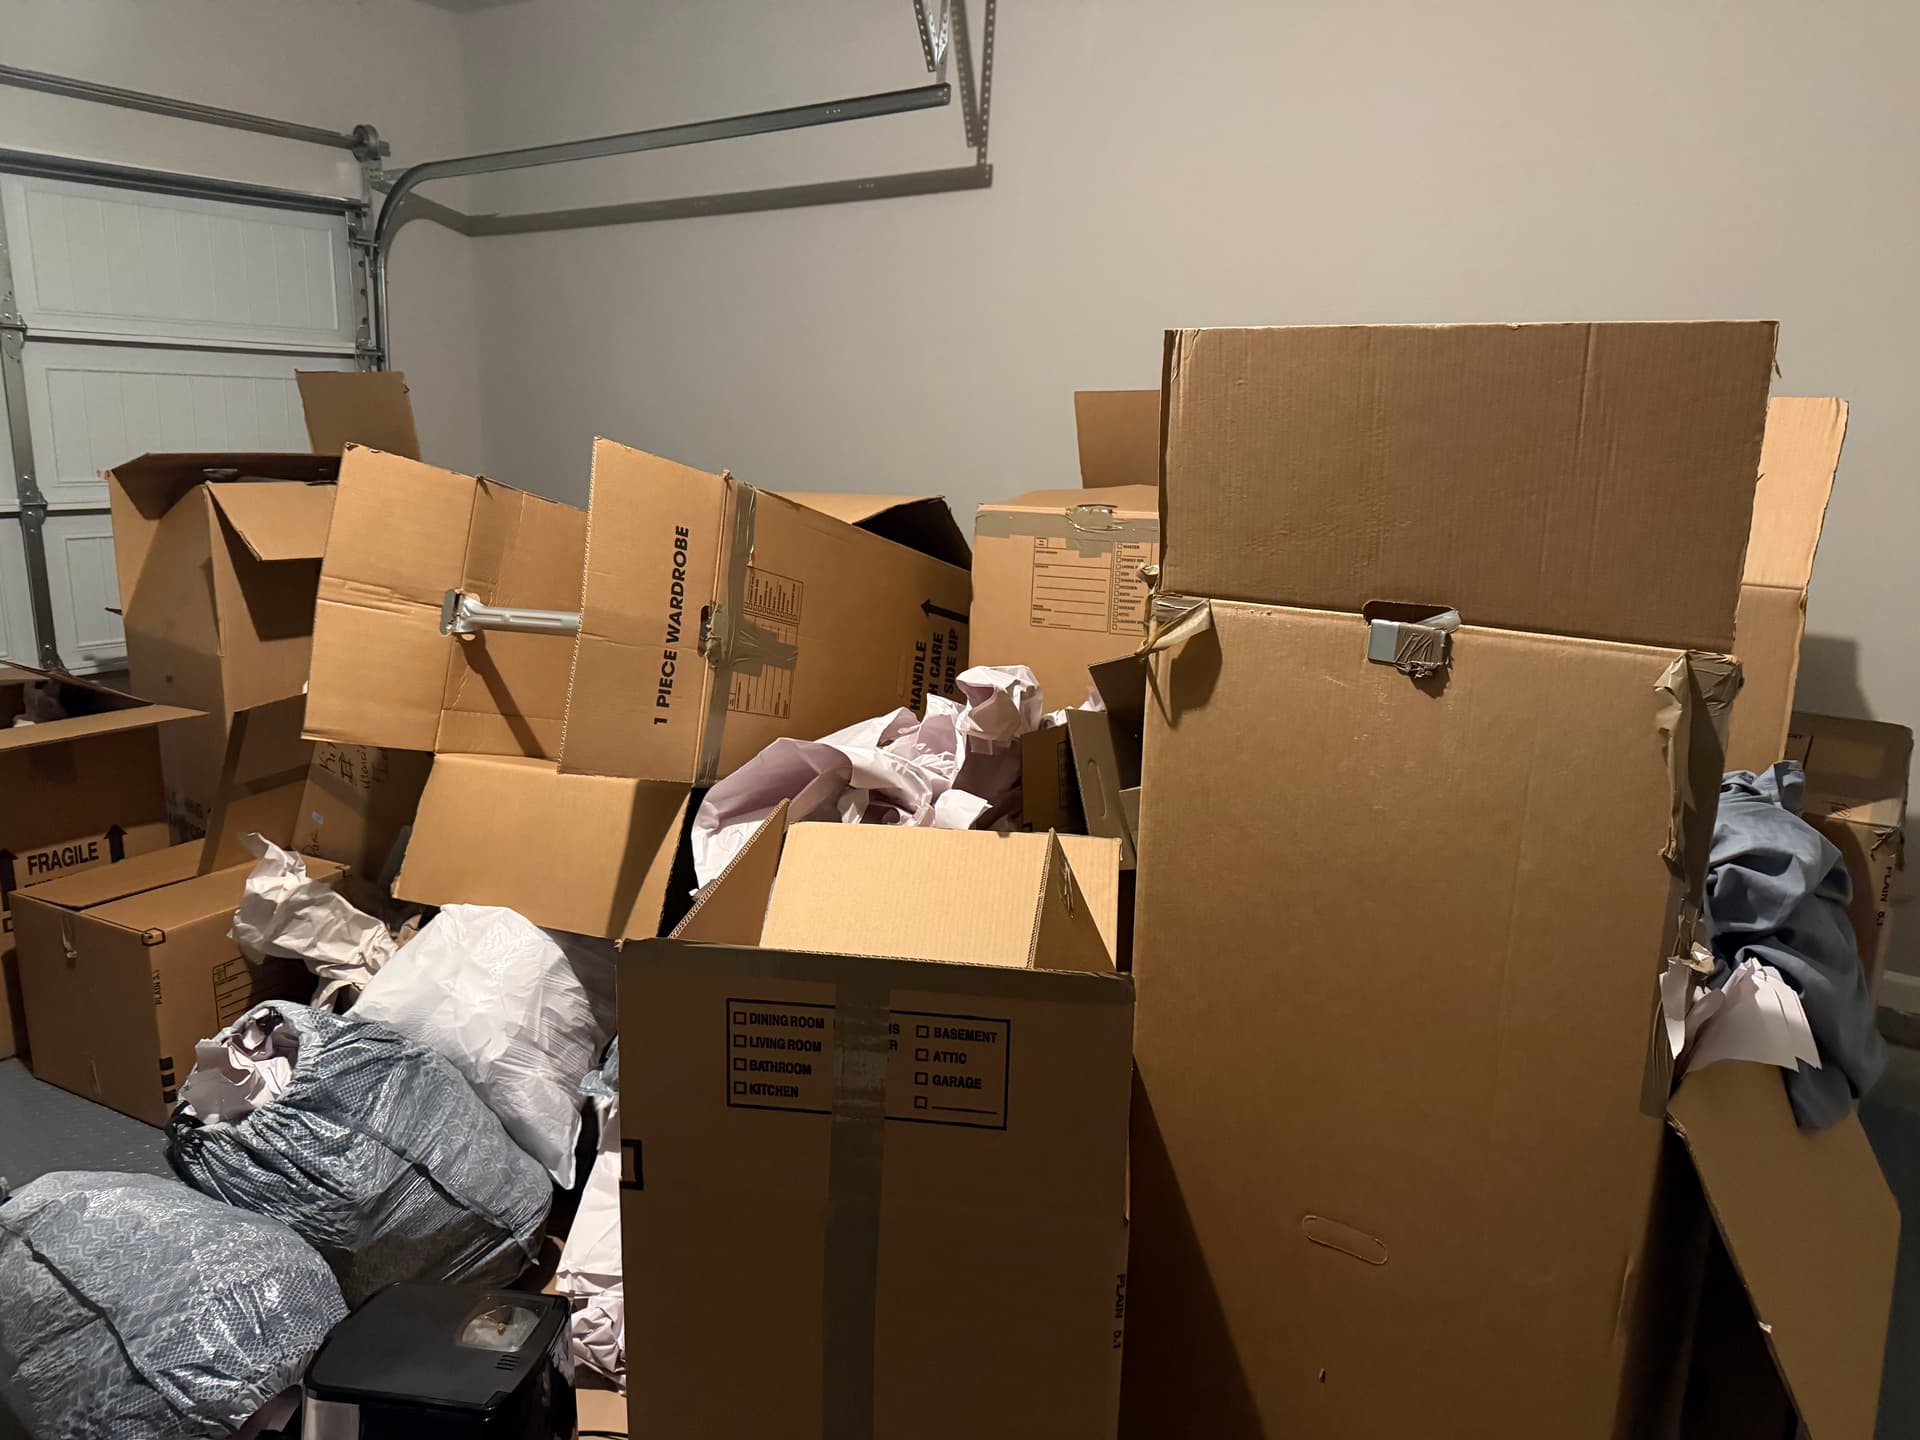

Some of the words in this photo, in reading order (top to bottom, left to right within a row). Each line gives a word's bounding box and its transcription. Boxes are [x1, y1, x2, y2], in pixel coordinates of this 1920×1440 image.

[665, 525, 690, 644] WARDROBE
[947, 629, 958, 651] UP
[929, 632, 944, 678] CARE
[656, 649, 677, 709] PIECE
[909, 640, 927, 711] HANDLE
[943, 656, 957, 695] SIDE
[654, 717, 668, 725] 1
[27, 841, 99, 876] FRAGILE
[749, 1013, 788, 1029] DINING
[789, 1016, 825, 1030] ROOM
[749, 1035, 787, 1051] LIVING
[787, 1039, 822, 1053] ROOM
[933, 1026, 998, 1044] BASEMENT
[749, 1058, 812, 1076] BATHROOM
[932, 1050, 968, 1065] ATTIC
[749, 1083, 798, 1098] KITCHEN
[932, 1074, 982, 1089] GARAGE
[1115, 1273, 1126, 1319] PLAIN
